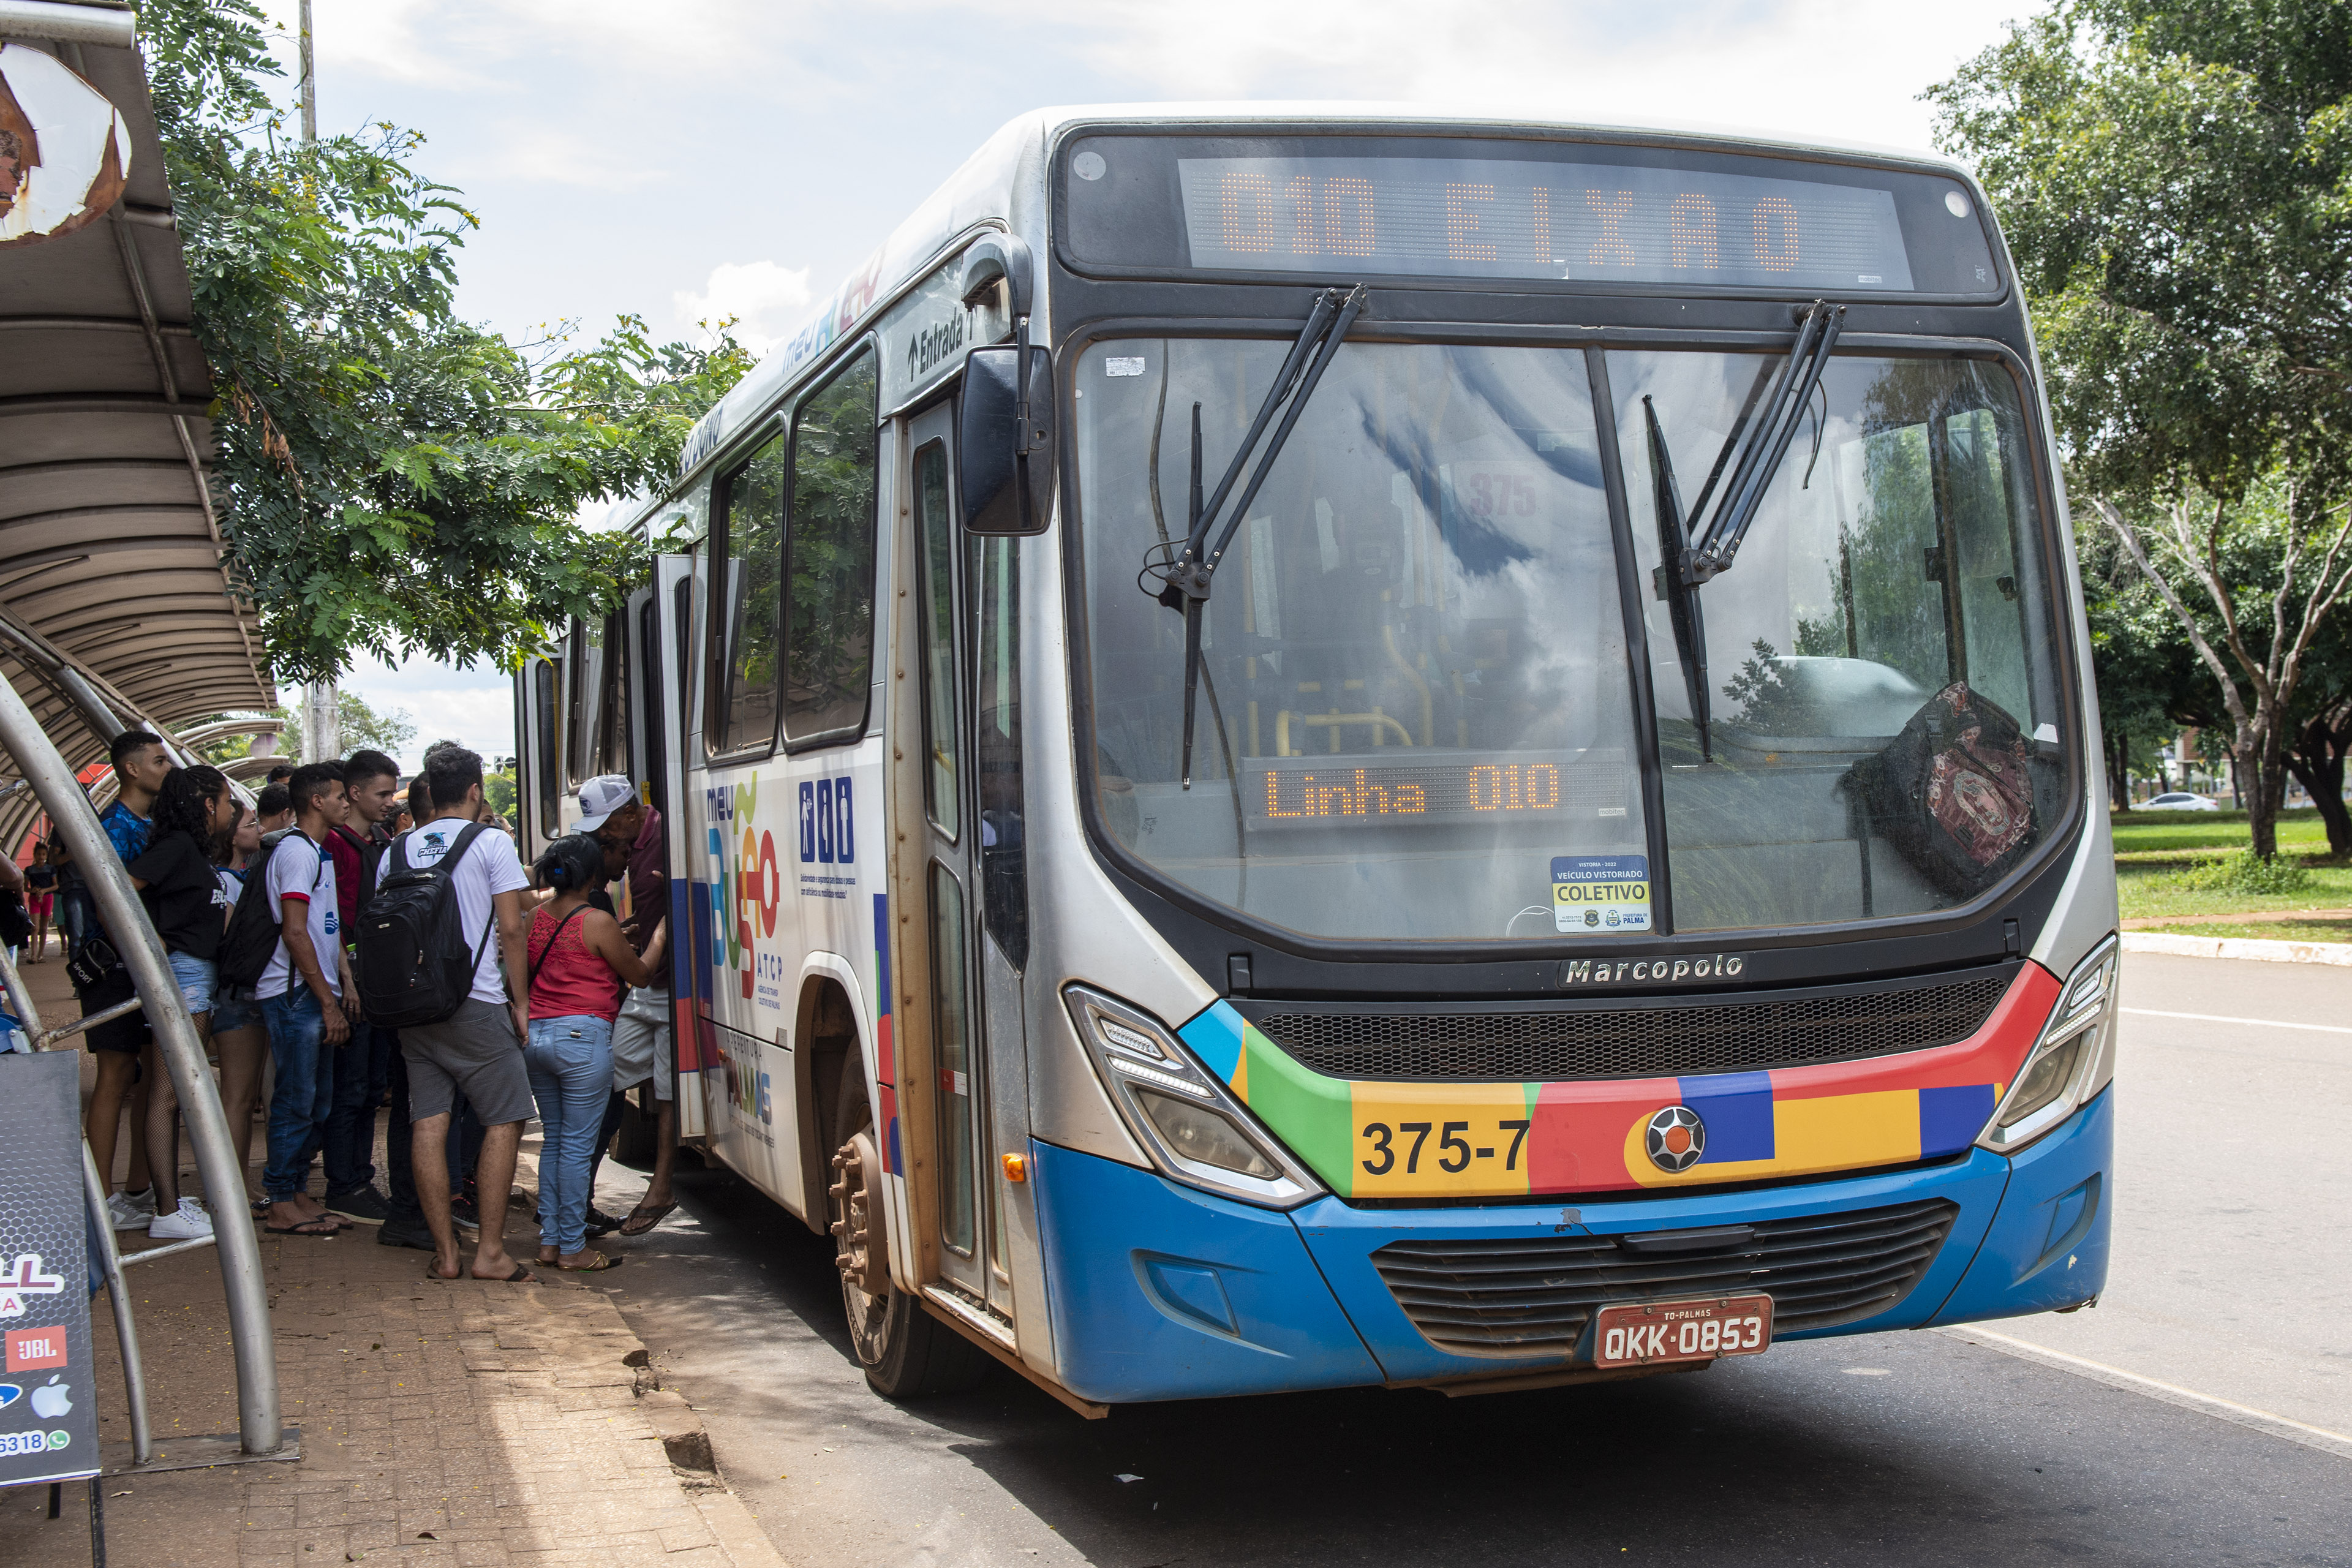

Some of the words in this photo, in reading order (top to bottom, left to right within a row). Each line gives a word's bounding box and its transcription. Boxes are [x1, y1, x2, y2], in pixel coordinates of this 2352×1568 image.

[1222, 173, 1375, 257] 010
[919, 306, 963, 375] Entrada
[1469, 472, 1536, 518] 375
[1268, 769, 1425, 816] Linha
[1471, 763, 1558, 810] 010
[418, 846, 447, 857] CHEFIA
[1557, 870, 1593, 880] VEÍCULO
[1558, 884, 1645, 901] COLETIVO
[74, 962, 94, 984] SPORT
[757, 951, 783, 982] ATCP
[1565, 954, 1743, 983] Marcopolo
[1360, 1120, 1531, 1176] 375-7
[0, 1298, 18, 1311] A
[1664, 1309, 1711, 1321] TO-PALMAS
[18, 1338, 57, 1360] JBL
